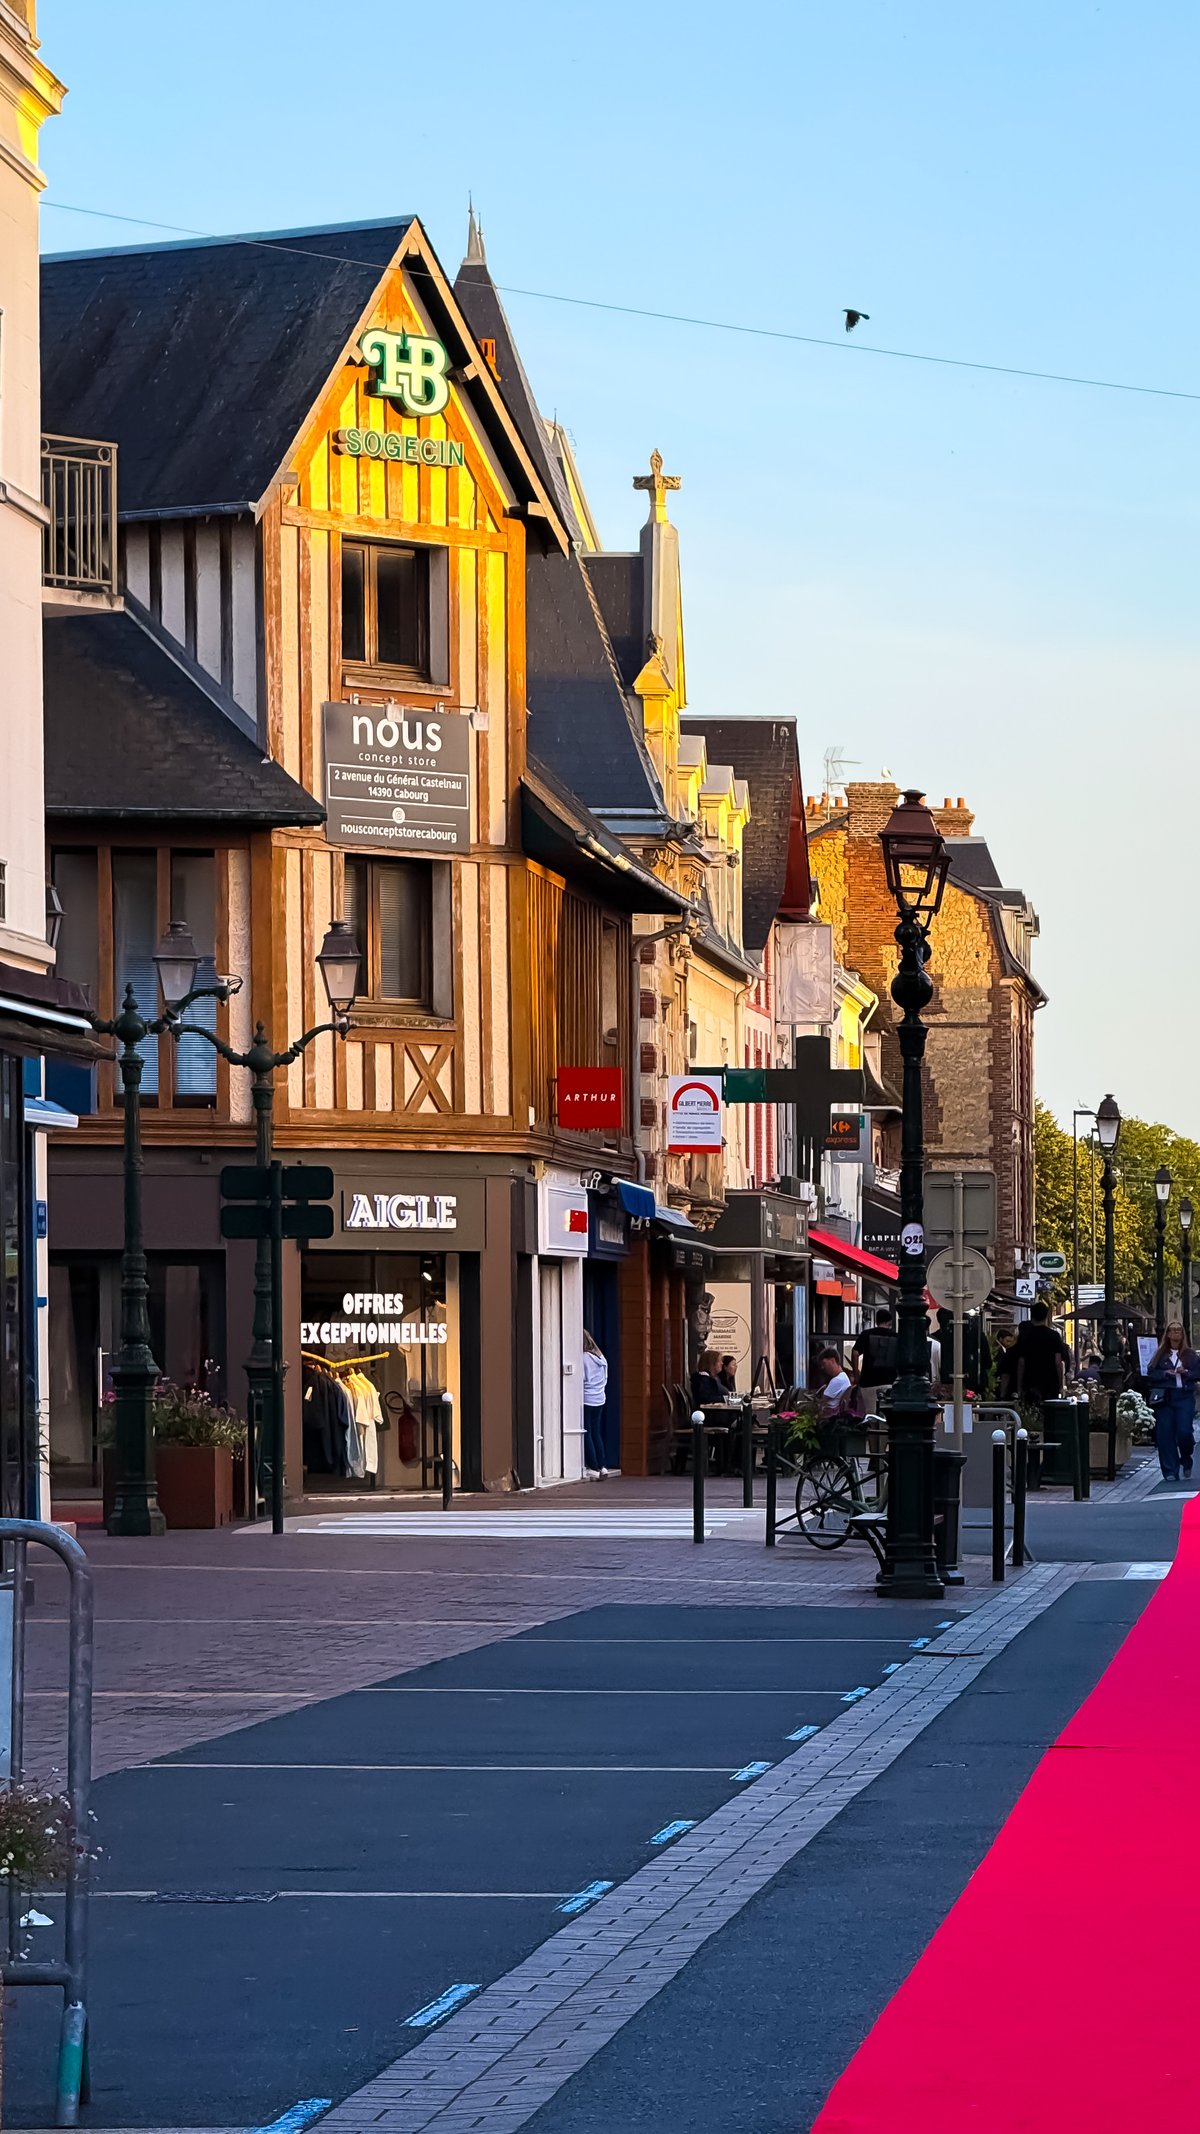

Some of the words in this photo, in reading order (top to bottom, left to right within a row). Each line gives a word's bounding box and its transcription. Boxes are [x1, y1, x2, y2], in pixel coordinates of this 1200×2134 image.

[346, 428, 464, 466] SOGECIN
[352, 714, 442, 752] nous
[358, 752, 403, 766] concept
[408, 756, 437, 767] store
[334, 769, 340, 780] 2
[342, 772, 372, 783] avenue
[374, 773, 385, 784] du
[387, 774, 419, 787] Général
[420, 776, 462, 790] Castelnau
[368, 786, 393, 798] 14390
[394, 788, 429, 802] Cabourg
[340, 824, 457, 843] nousconceptstorecabourg
[565, 1093, 617, 1102] ARTHUR
[825, 1136, 857, 1145] express
[346, 1194, 457, 1229] AIGLE
[342, 1293, 404, 1314] OFFRES
[300, 1322, 448, 1344] EXCEPTIONNELLES
